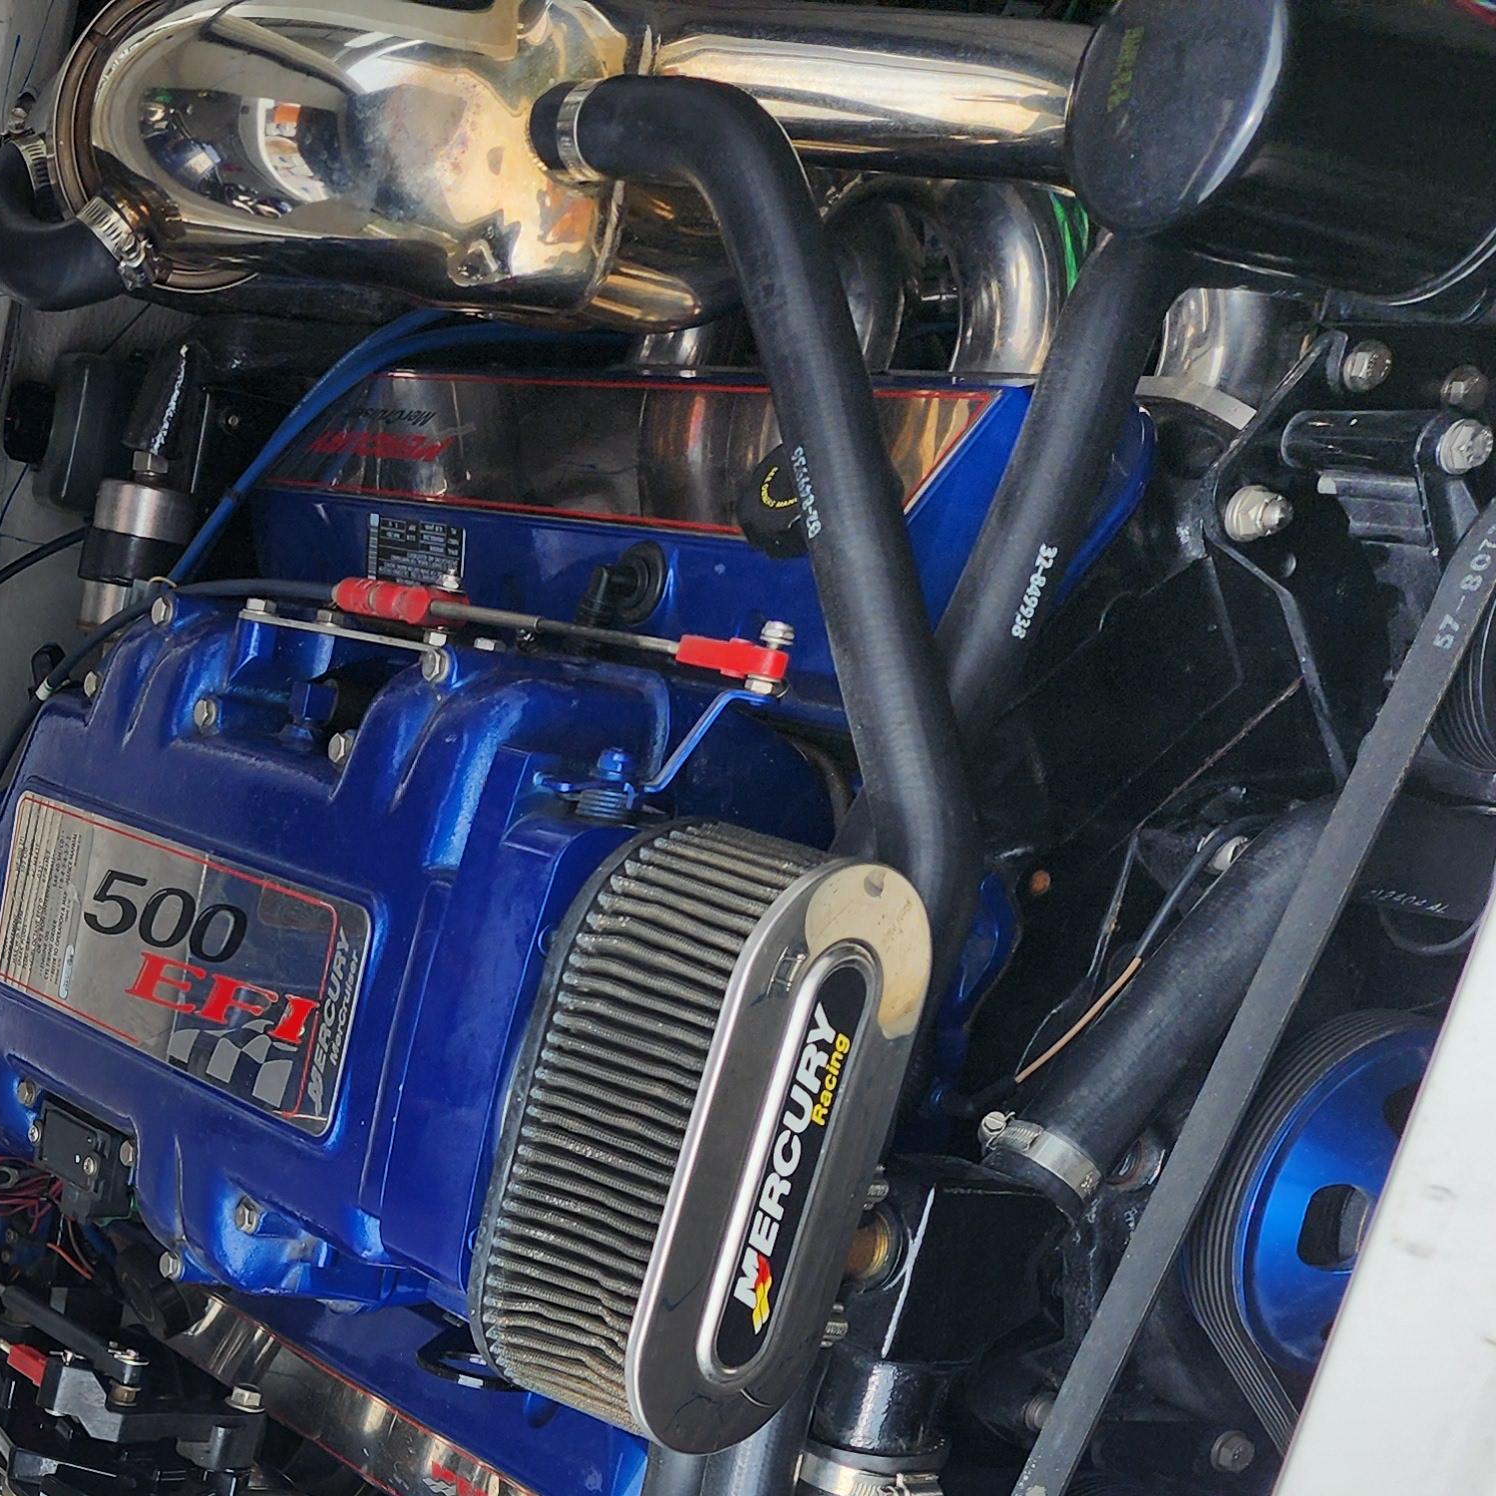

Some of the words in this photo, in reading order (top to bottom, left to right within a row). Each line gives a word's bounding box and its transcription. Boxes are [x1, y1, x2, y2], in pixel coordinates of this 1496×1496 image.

[83, 868, 248, 964] 500
[124, 949, 321, 1047] EFI
[306, 926, 350, 1115] MERCURY
[327, 947, 362, 1069] MerCruiser
[811, 1031, 851, 1128] Racing
[733, 1001, 839, 1332] MERCURY
